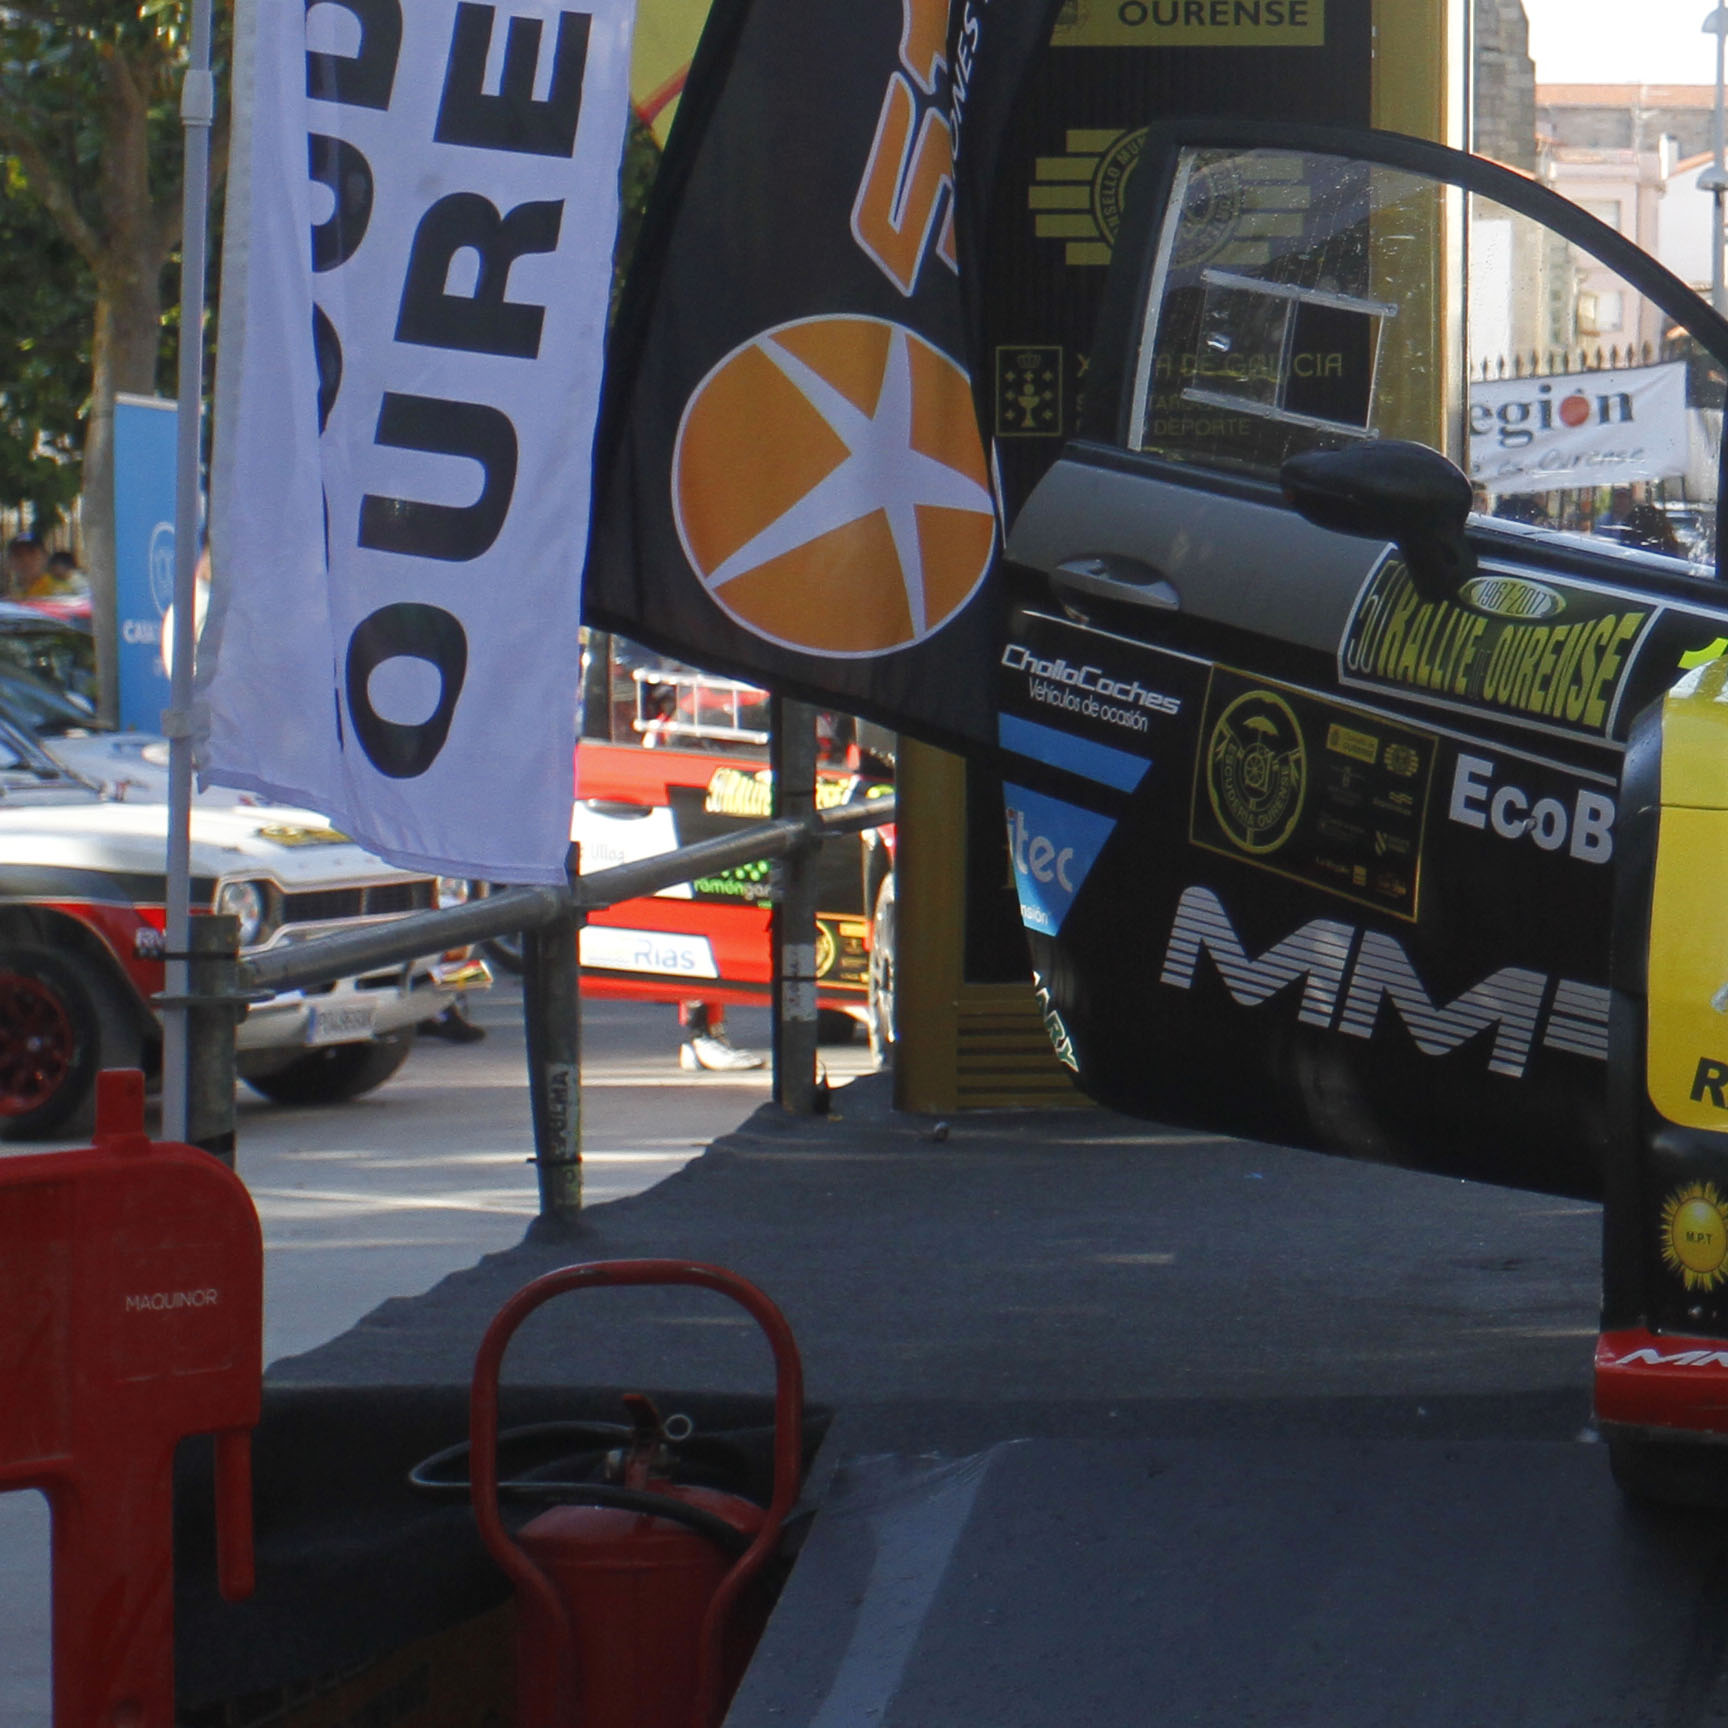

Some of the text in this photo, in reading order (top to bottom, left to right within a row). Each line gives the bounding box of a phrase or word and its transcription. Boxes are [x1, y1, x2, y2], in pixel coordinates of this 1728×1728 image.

[1117, 0, 1309, 27] OURENSE
[1377, 574, 1489, 696] RALLYE
[1482, 611, 1648, 727] OURENSE
[1082, 695, 1100, 718] de
[1100, 704, 1149, 733] ocasión
[1447, 752, 1616, 865] EcoB
[125, 1288, 219, 1312] MAQUINOR
